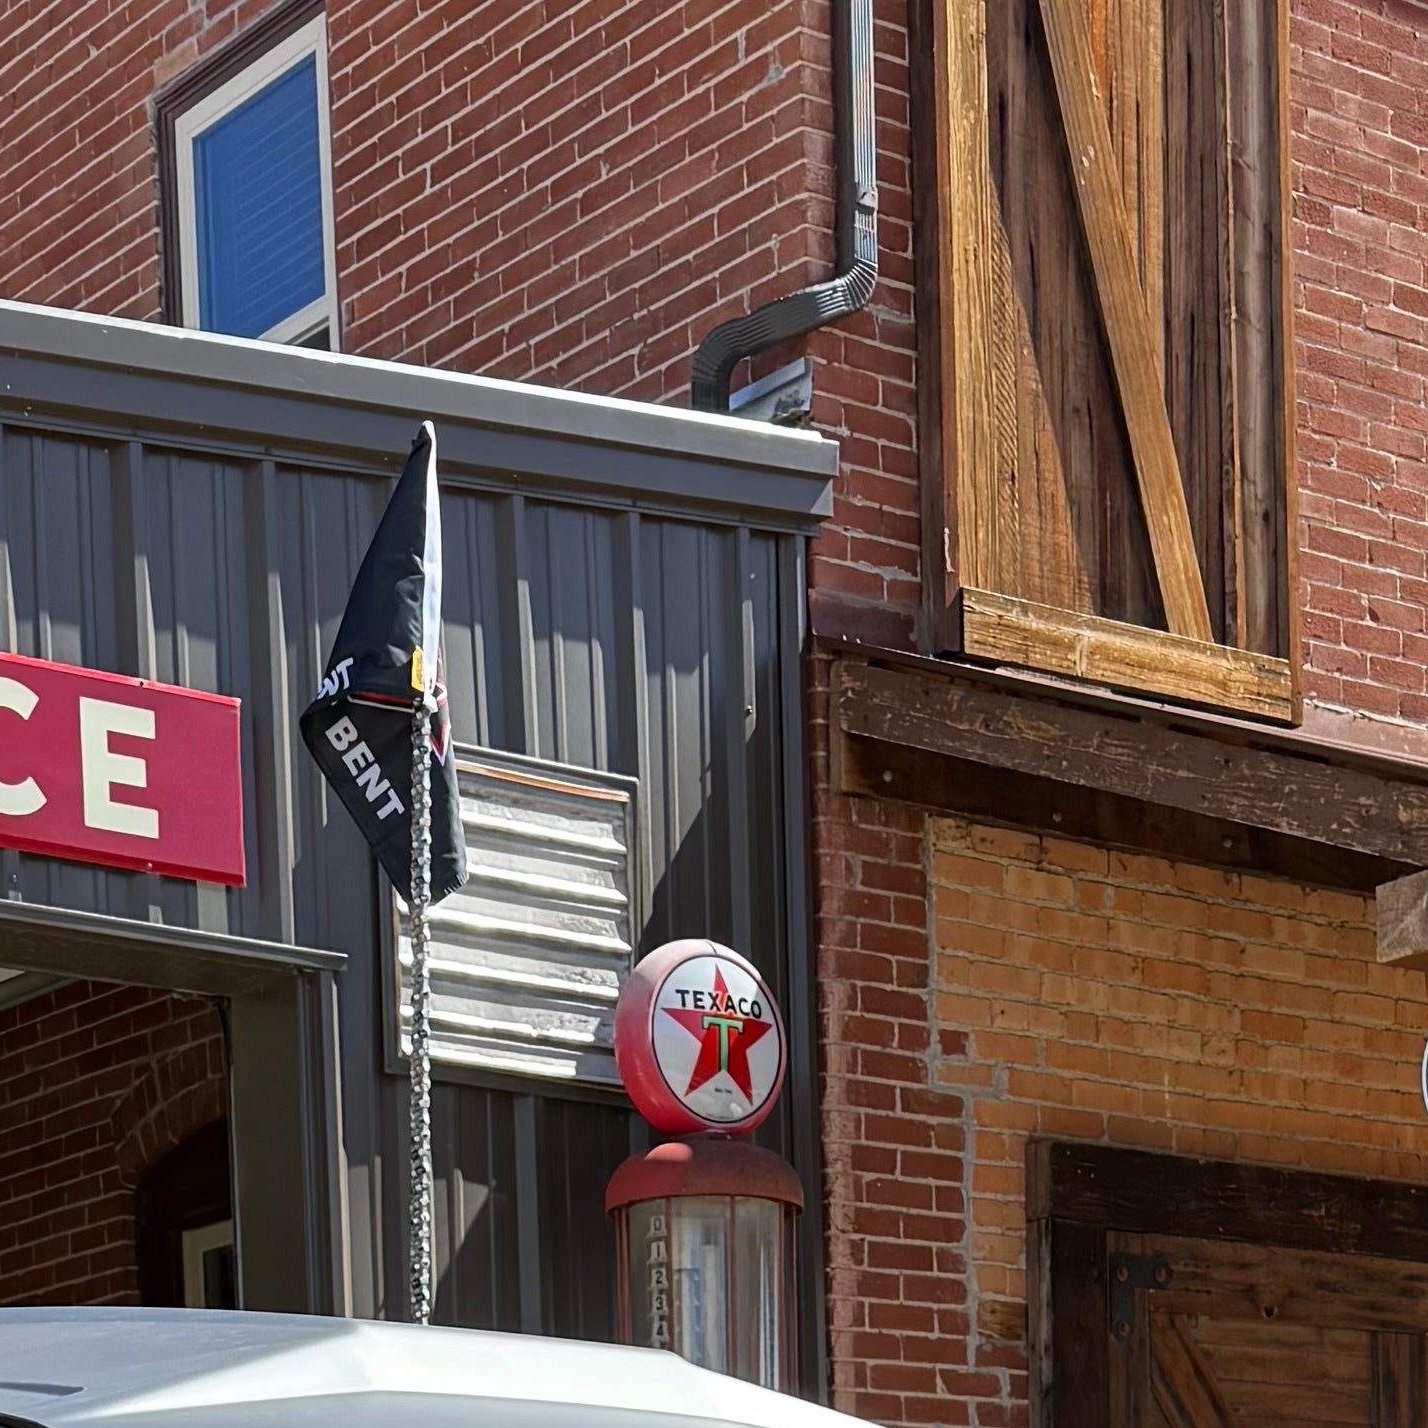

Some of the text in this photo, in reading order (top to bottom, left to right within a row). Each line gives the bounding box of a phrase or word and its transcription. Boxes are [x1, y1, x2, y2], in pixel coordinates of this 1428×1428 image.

[324, 714, 405, 822] BENT
[674, 988, 762, 1020] TEXACO
[655, 1270, 663, 1285] 2
[655, 1296, 664, 1311] 3
[656, 1323, 664, 1337] 4
